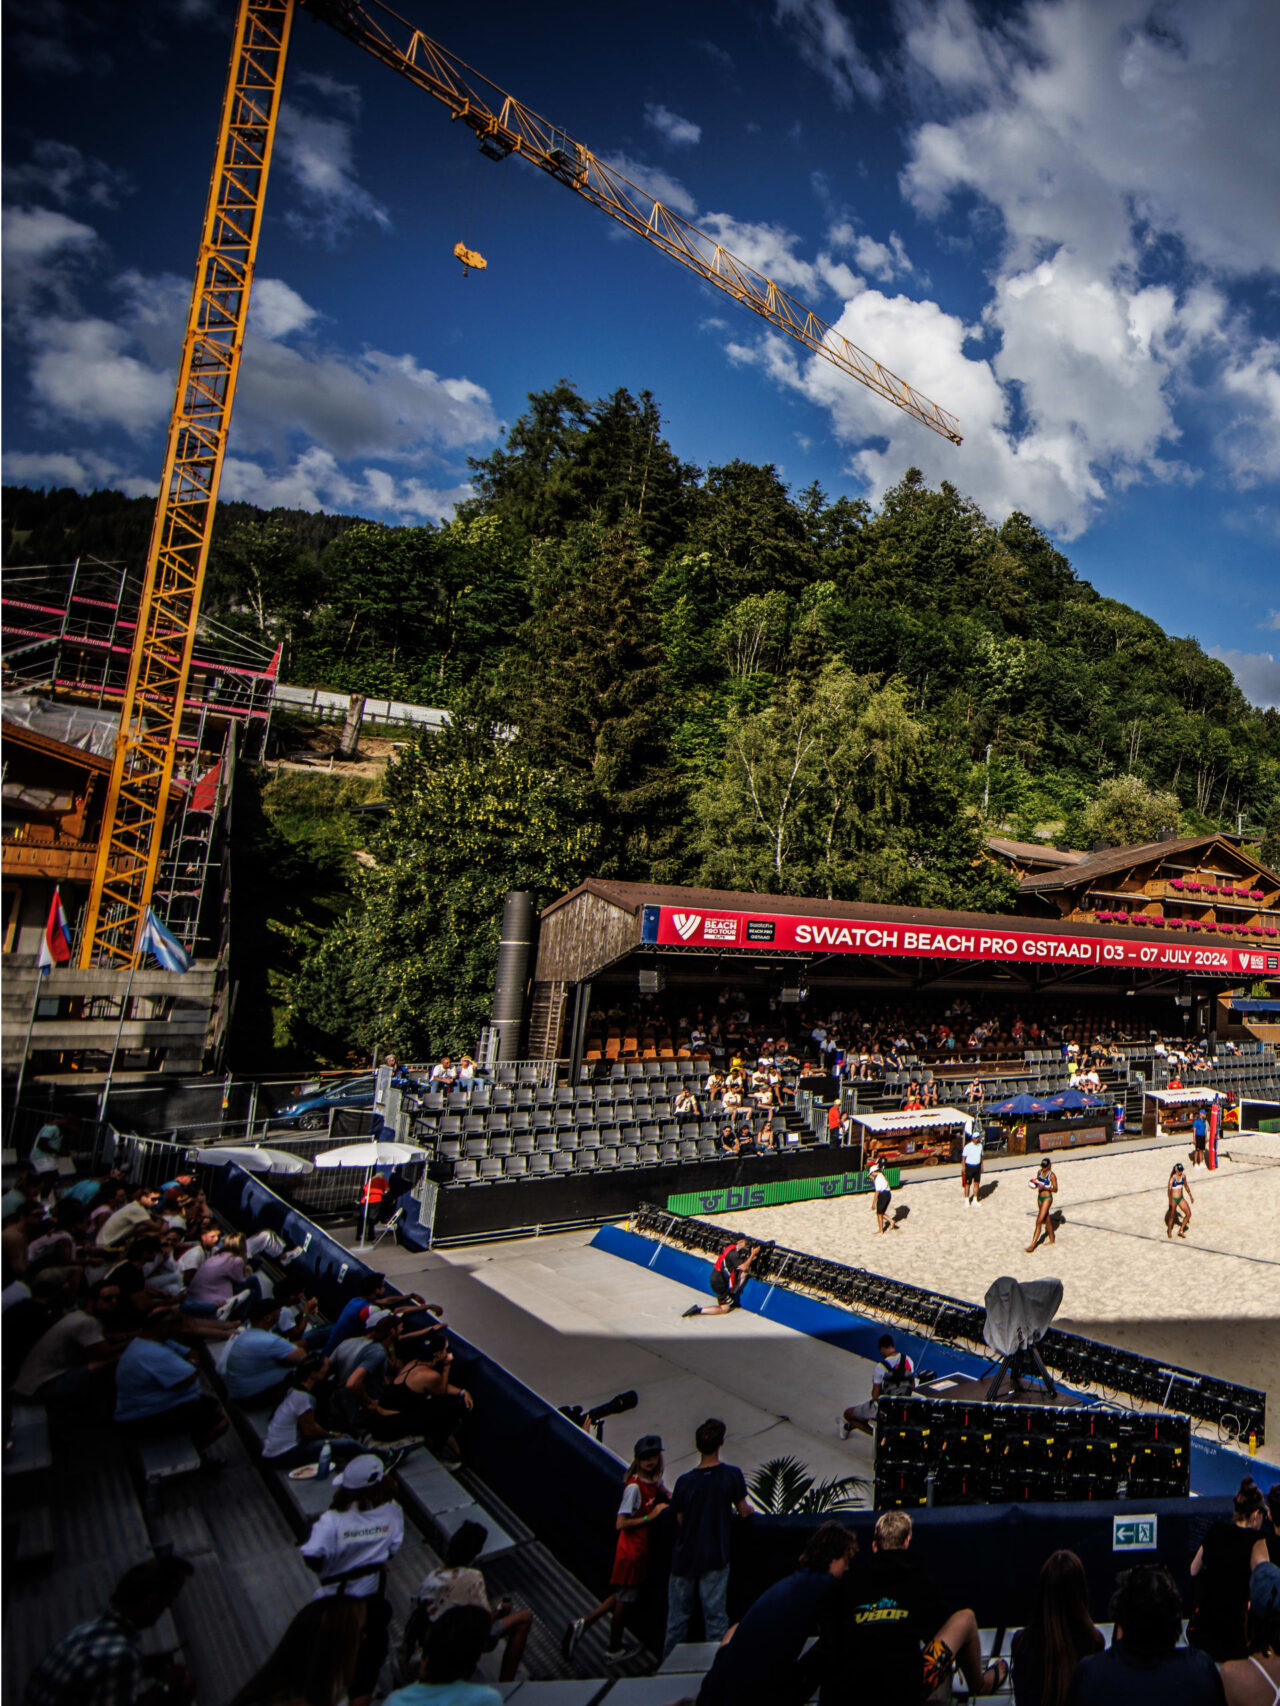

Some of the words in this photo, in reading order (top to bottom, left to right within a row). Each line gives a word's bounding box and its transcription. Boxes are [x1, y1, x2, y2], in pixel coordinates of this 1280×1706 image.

[705, 920, 737, 930] BEACH
[795, 924, 898, 948] SWATCH
[904, 932, 975, 953] BEACH
[980, 937, 1018, 954] PRO
[1022, 939, 1092, 959] GSTAAD
[1104, 945, 1124, 960] 03
[1141, 947, 1158, 962] 07
[1160, 948, 1193, 964] JULY
[1195, 951, 1228, 966] 2024
[843, 1170, 875, 1193] bls
[726, 1188, 764, 1209] bls
